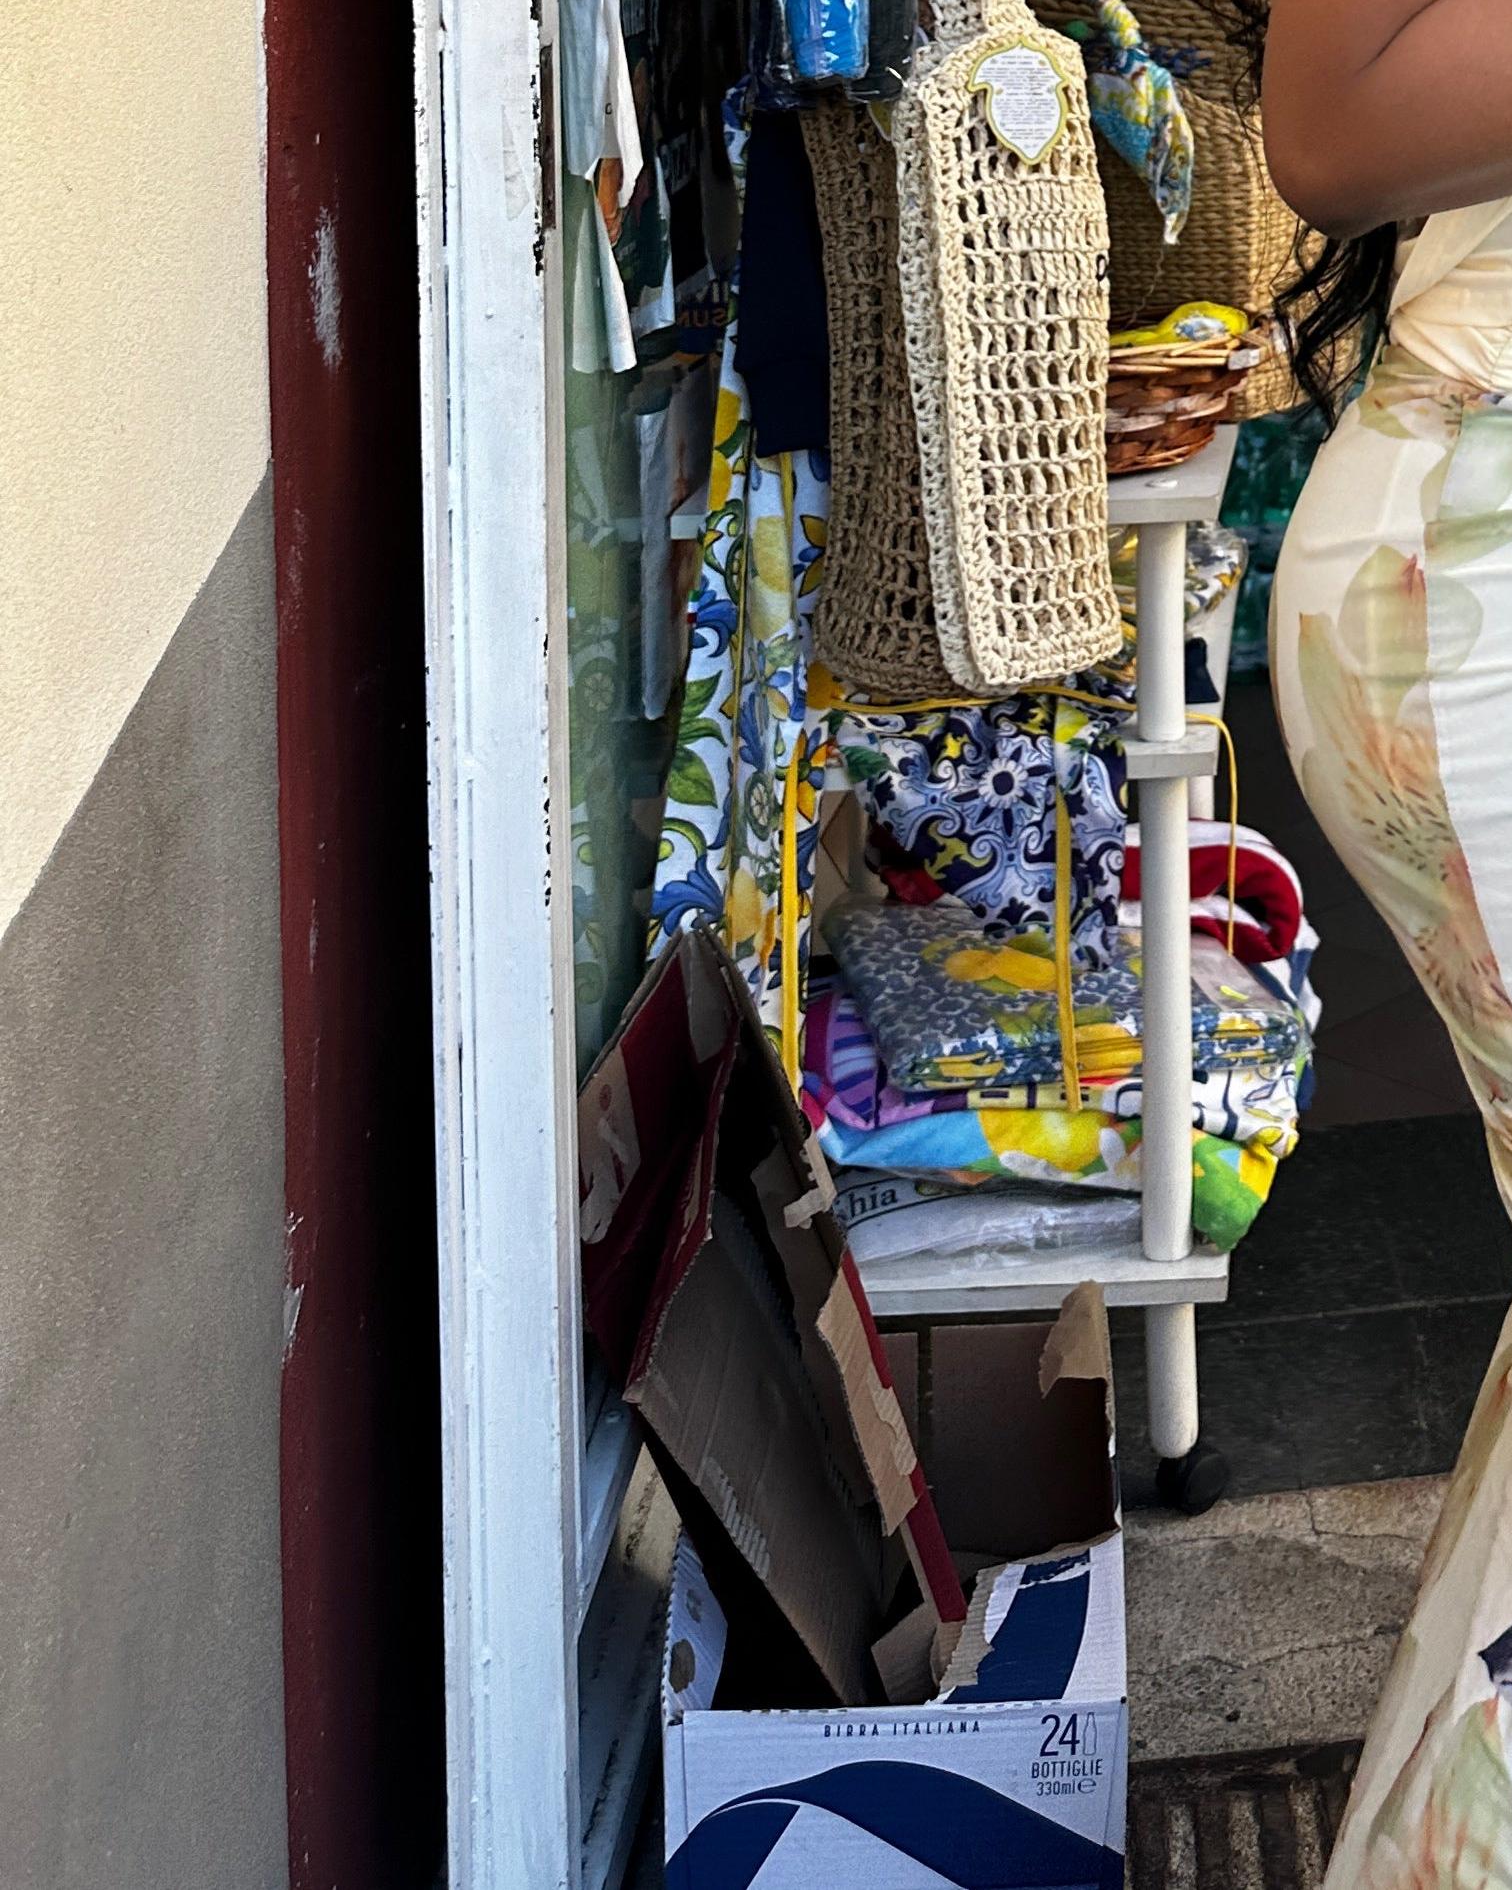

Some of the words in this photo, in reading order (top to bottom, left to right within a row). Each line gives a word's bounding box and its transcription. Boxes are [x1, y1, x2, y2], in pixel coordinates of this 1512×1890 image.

[823, 1724, 879, 1738] BIRRA
[893, 1720, 981, 1737] ITALIANA
[1039, 1713, 1080, 1757] 24
[1031, 1758, 1103, 1779] BOTTIGLIE
